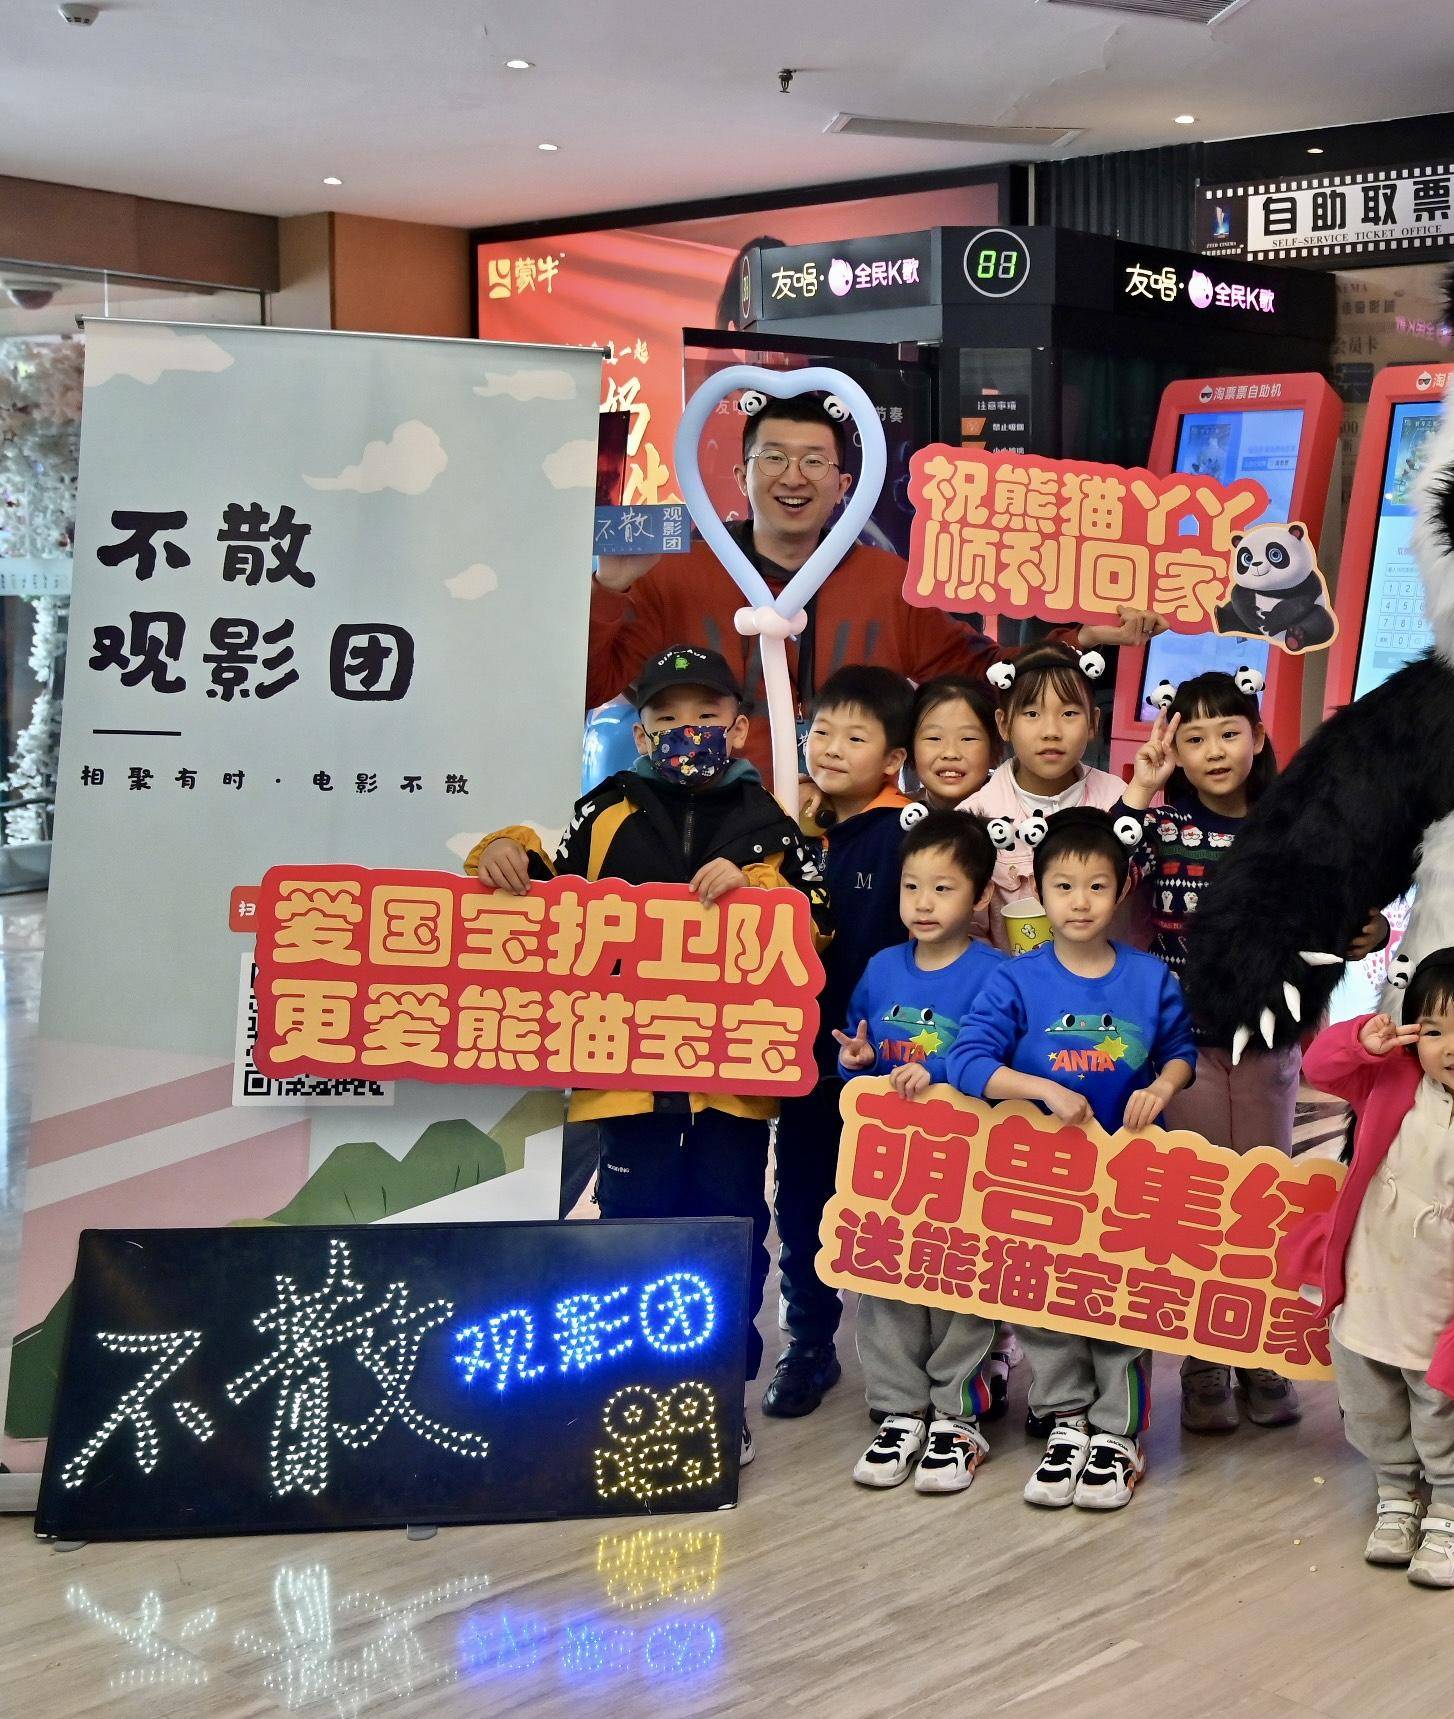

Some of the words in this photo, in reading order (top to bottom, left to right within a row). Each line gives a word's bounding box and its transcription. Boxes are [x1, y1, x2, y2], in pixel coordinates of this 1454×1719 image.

[1262, 177, 1451, 237] 自助取票
[1272, 233, 1349, 248] SELF-SERVICE
[1355, 228, 1396, 240] TICKET
[1401, 224, 1442, 237] OFFICE
[514, 255, 560, 295] 蒙牛
[855, 257, 920, 289] 全民K歌
[1214, 281, 1275, 313] 全民K歌
[1213, 383, 1282, 401] 淘票票自助机
[595, 506, 656, 544] 不散
[662, 506, 683, 551] 观影团
[922, 455, 1256, 552] 祝熊猫丫丫
[97, 502, 316, 588] 不散
[916, 519, 1228, 623] 顺利回家
[89, 609, 415, 702] 观影团
[853, 871, 873, 890] M
[272, 880, 810, 987] 爱国宝护卫队
[269, 978, 805, 1083] 更爱熊猫宝宝
[1051, 1049, 1116, 1073] ANTA
[830, 1207, 1333, 1367] 送熊猫宝宝回家
[61, 1239, 492, 1498] 不散
[453, 1271, 715, 1393] 观影团
